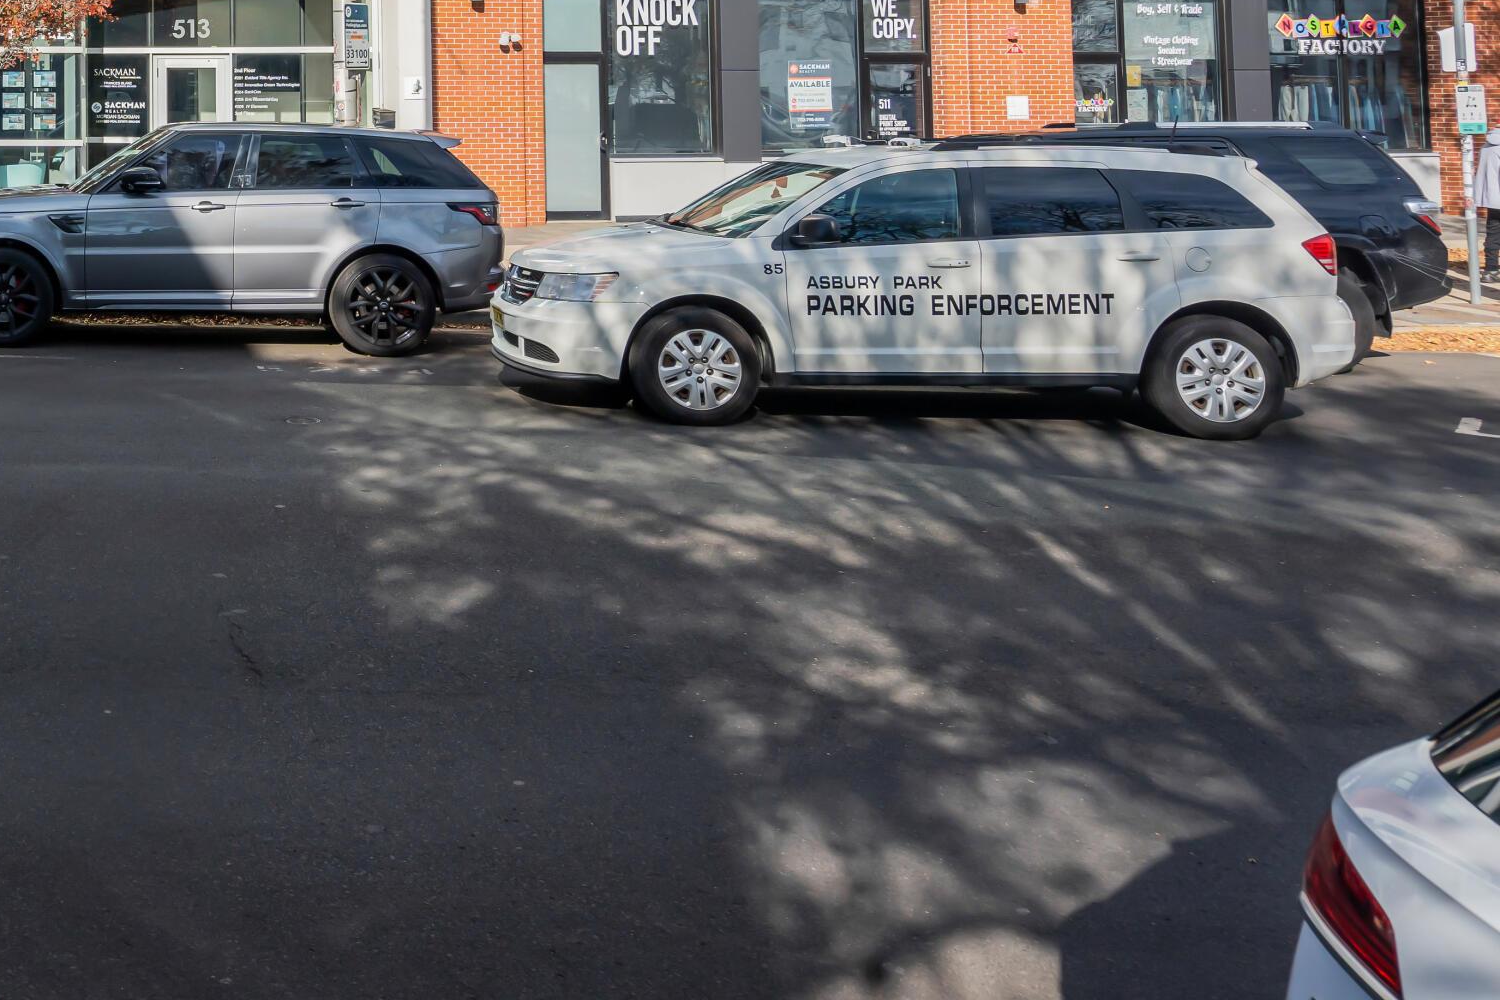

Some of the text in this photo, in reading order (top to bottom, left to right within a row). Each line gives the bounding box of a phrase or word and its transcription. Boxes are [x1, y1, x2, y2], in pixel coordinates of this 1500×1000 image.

[1157, 4, 1172, 14] Sell
[1180, 4, 1203, 14] Trade
[172, 18, 211, 39] 513
[872, 18, 917, 39] COPY.
[616, 26, 663, 56] OFF
[1143, 36, 1199, 46] Vintage Clothing
[1298, 39, 1386, 55] FACTORY
[346, 49, 368, 59] 33100
[1157, 57, 1193, 66] Streetwear
[93, 67, 136, 79] SACKMAN
[789, 80, 831, 88] AVAILABLE
[104, 101, 146, 109] SACKMAN
[878, 98, 891, 110] 511
[763, 263, 784, 275] 85
[807, 275, 943, 290] ASBURY PARK
[806, 293, 1115, 316] PARKING ENFORCEMENT
